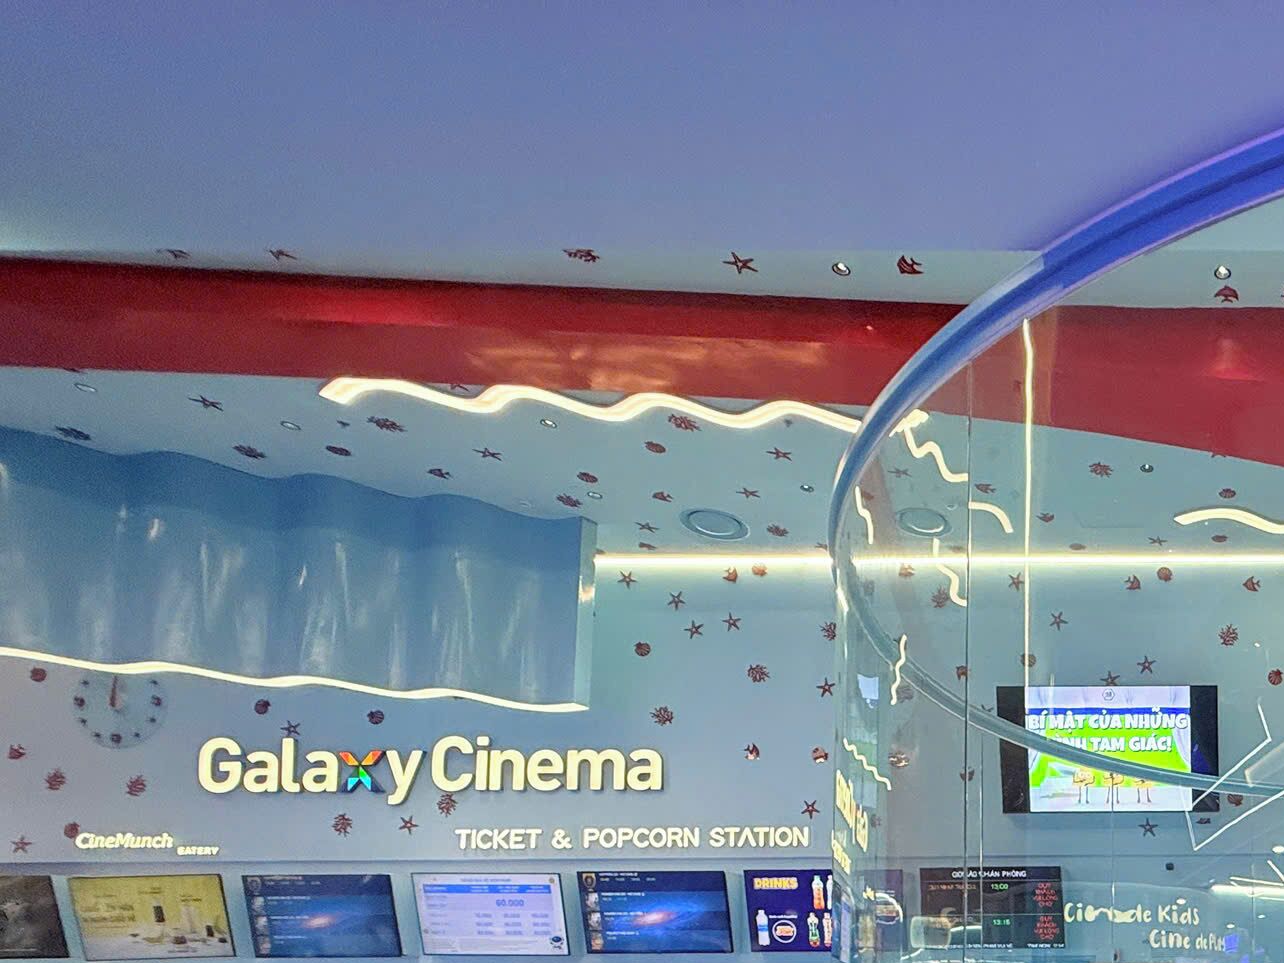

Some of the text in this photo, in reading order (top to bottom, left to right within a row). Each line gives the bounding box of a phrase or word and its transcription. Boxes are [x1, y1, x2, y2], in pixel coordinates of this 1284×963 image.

[1028, 706, 1188, 734] BÍ MẬT CỦA NHỮNG
[1089, 736, 1125, 752] TAM
[1128, 733, 1172, 752] GIÁC!
[197, 735, 664, 805] Galaxy Cinema
[75, 832, 219, 856] CineMunch EATERY
[455, 825, 810, 850] TICKET & POPCORN STATION
[753, 877, 798, 890] DRINKS
[1149, 928, 1191, 950] Cine
